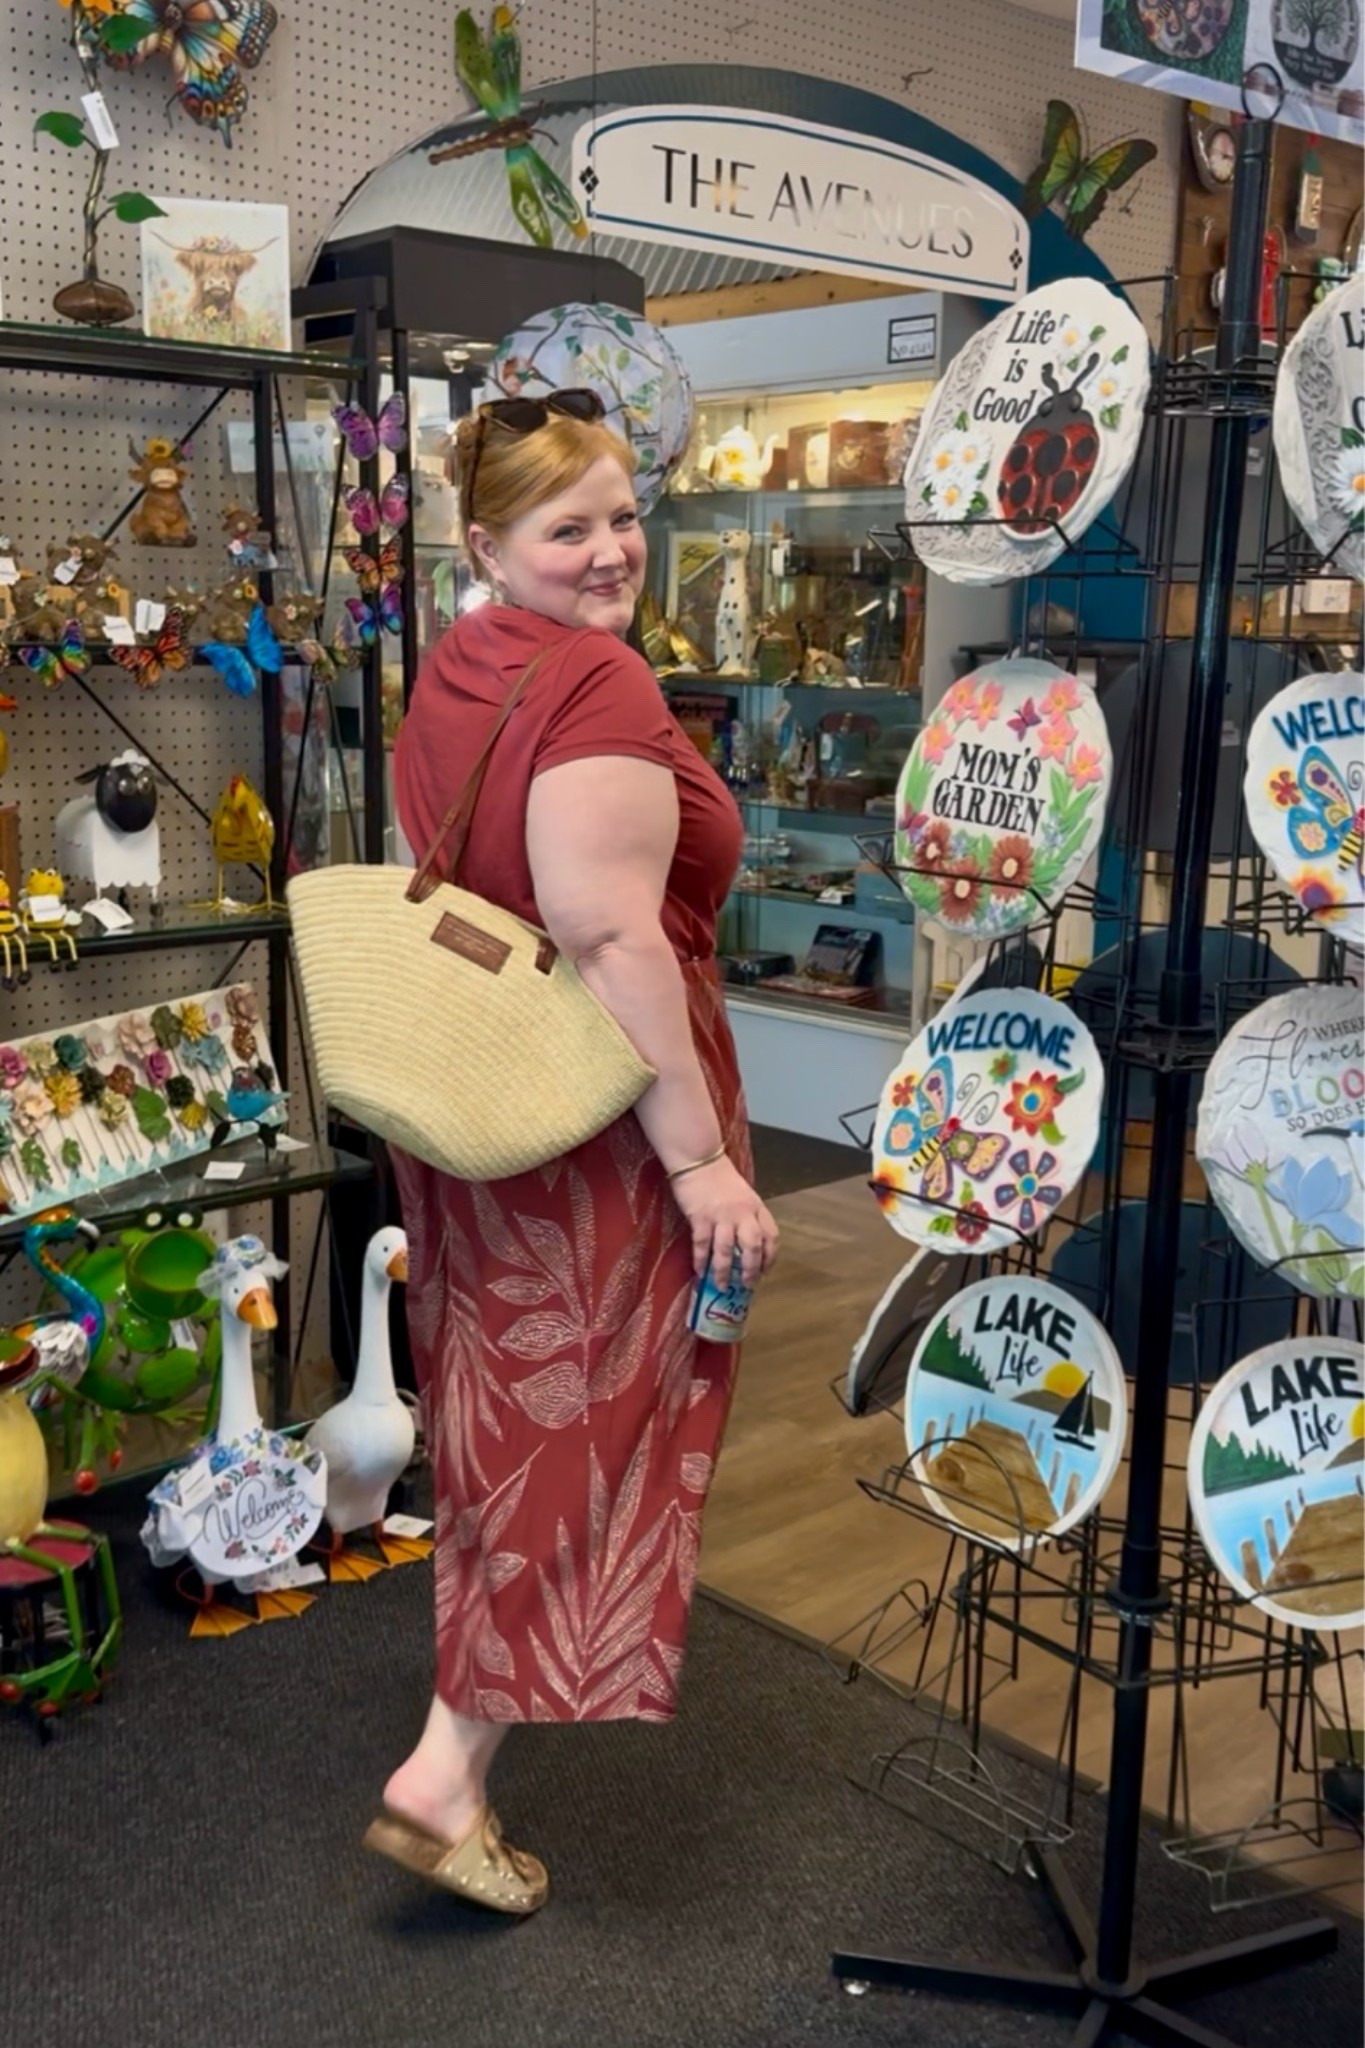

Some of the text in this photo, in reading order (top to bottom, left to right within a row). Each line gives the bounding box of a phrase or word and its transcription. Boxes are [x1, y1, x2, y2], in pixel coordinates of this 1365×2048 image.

[652, 144, 974, 258] THE AVENUES
[1005, 309, 1056, 345] Life
[1003, 348, 1028, 383] is
[973, 387, 1038, 424] Good
[950, 742, 1042, 793] MOM'S
[932, 777, 1046, 836] GARDEN
[927, 1011, 1075, 1070] WELCOME
[1287, 1116, 1307, 1132] SO
[1312, 1104, 1353, 1127] DOES
[974, 1293, 1077, 1361] LAKE
[996, 1335, 1043, 1387] Life
[1240, 1356, 1364, 1428] LAKE
[1290, 1403, 1343, 1459] Life
[202, 1478, 306, 1544] Welcome
